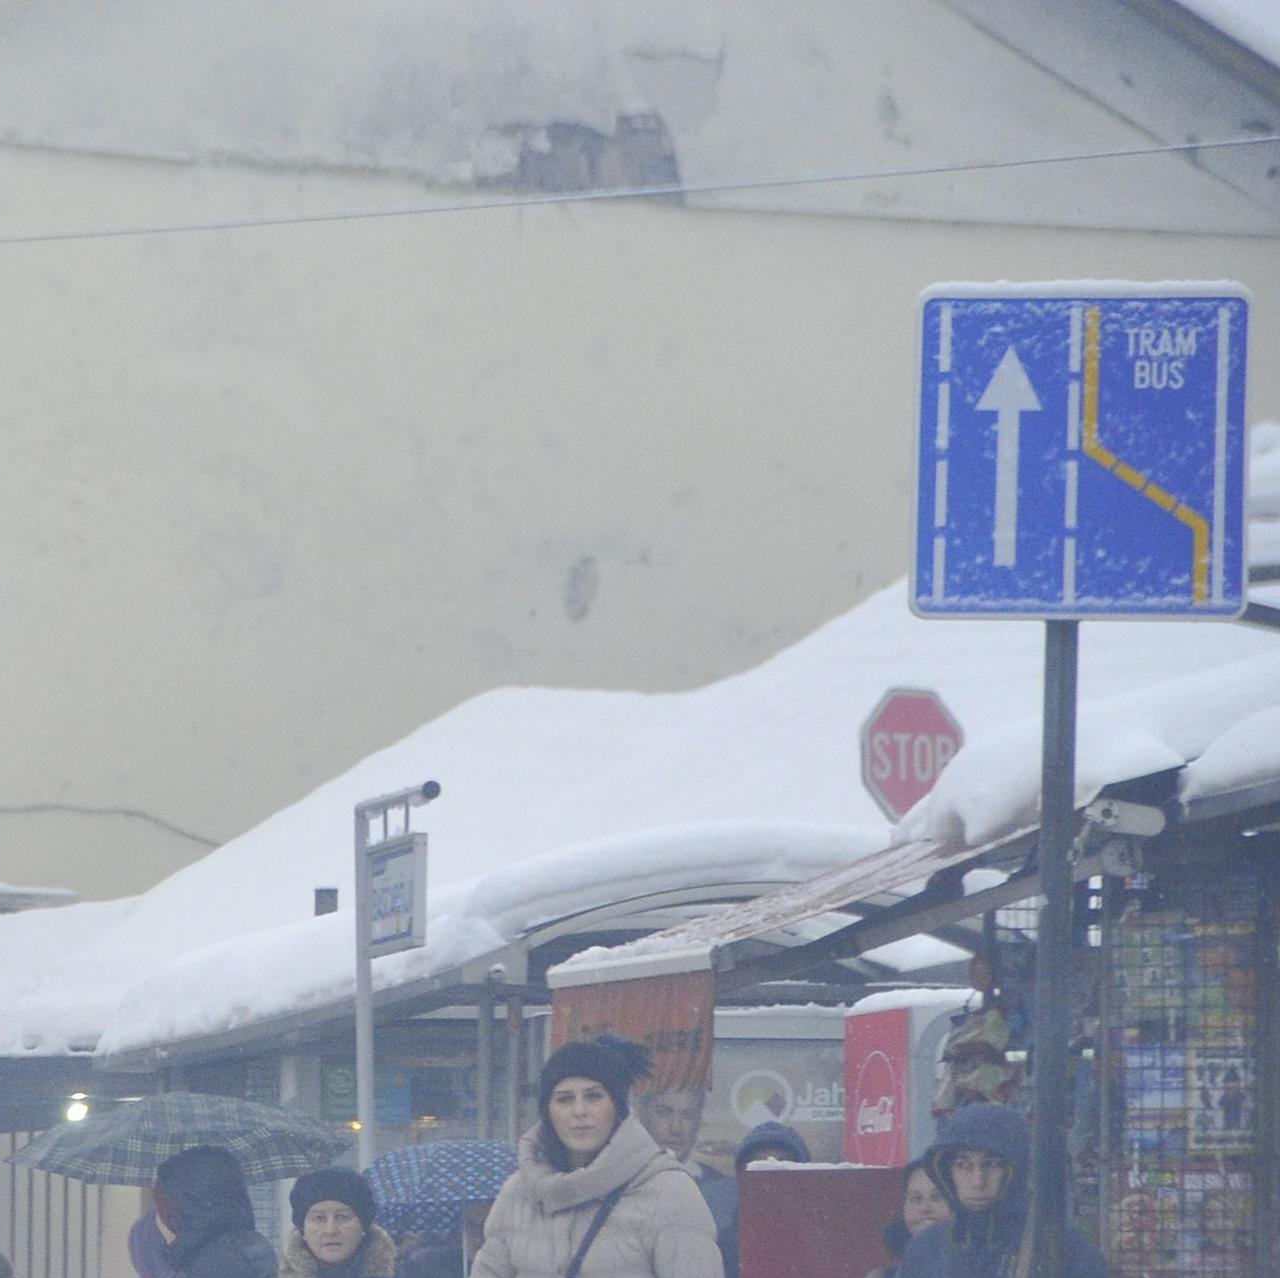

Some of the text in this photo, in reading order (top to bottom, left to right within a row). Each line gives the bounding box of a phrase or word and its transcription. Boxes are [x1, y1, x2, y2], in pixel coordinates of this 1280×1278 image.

[1125, 327, 1198, 358] TRAM
[1133, 359, 1186, 390] BUS
[872, 731, 956, 783] STOP
[795, 1081, 846, 1107] Jah
